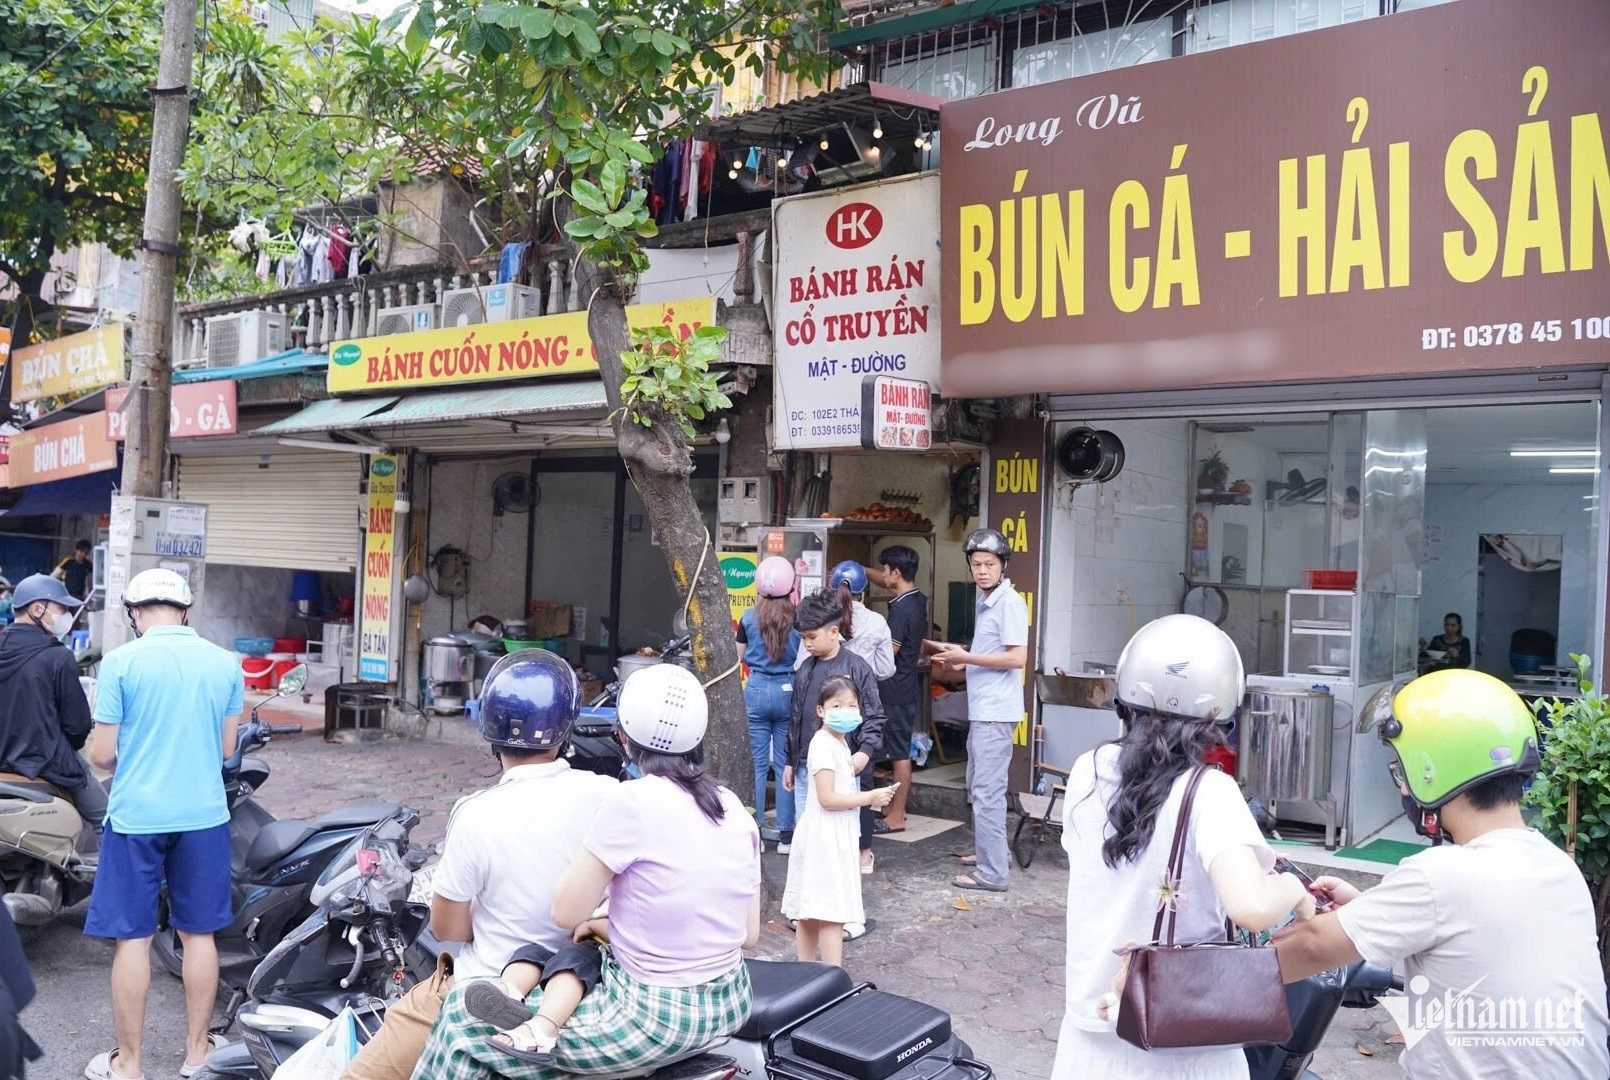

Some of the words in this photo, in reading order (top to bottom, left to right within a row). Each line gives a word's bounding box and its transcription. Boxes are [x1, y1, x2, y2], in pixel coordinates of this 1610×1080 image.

[964, 117, 1064, 152] Long
[1076, 94, 1145, 130] Vũ
[960, 169, 1085, 325] BÚN
[1109, 144, 1201, 313] CÁ
[1278, 97, 1410, 298] HẢI
[1443, 65, 1610, 283] SẢN
[836, 208, 873, 243] HK
[789, 266, 858, 303] BÁNH
[866, 254, 926, 293] RÁN
[785, 303, 816, 346] CỔ
[823, 294, 930, 342] TRUYỀN
[1422, 327, 1457, 350] ĐT:
[1463, 322, 1523, 347] 0378
[1531, 320, 1562, 342] 45
[22, 349, 62, 385] BÚN
[66, 331, 110, 375] CHẢ
[366, 346, 424, 384] BÁNH
[430, 332, 493, 377] CUỐN
[499, 331, 570, 373] NÓNG
[808, 357, 839, 381] MẬT
[851, 351, 906, 374] ĐƯỜNG
[881, 379, 909, 407] BÁNH
[197, 393, 231, 431] GÀ
[812, 408, 838, 419] 102E2
[34, 436, 58, 473] BÚN
[995, 451, 1037, 493] BÚN
[369, 500, 393, 534] BÁNH
[367, 540, 391, 578] CUỐN
[364, 587, 388, 621] NÓNG
[896, 1036, 933, 1064] HONDA
